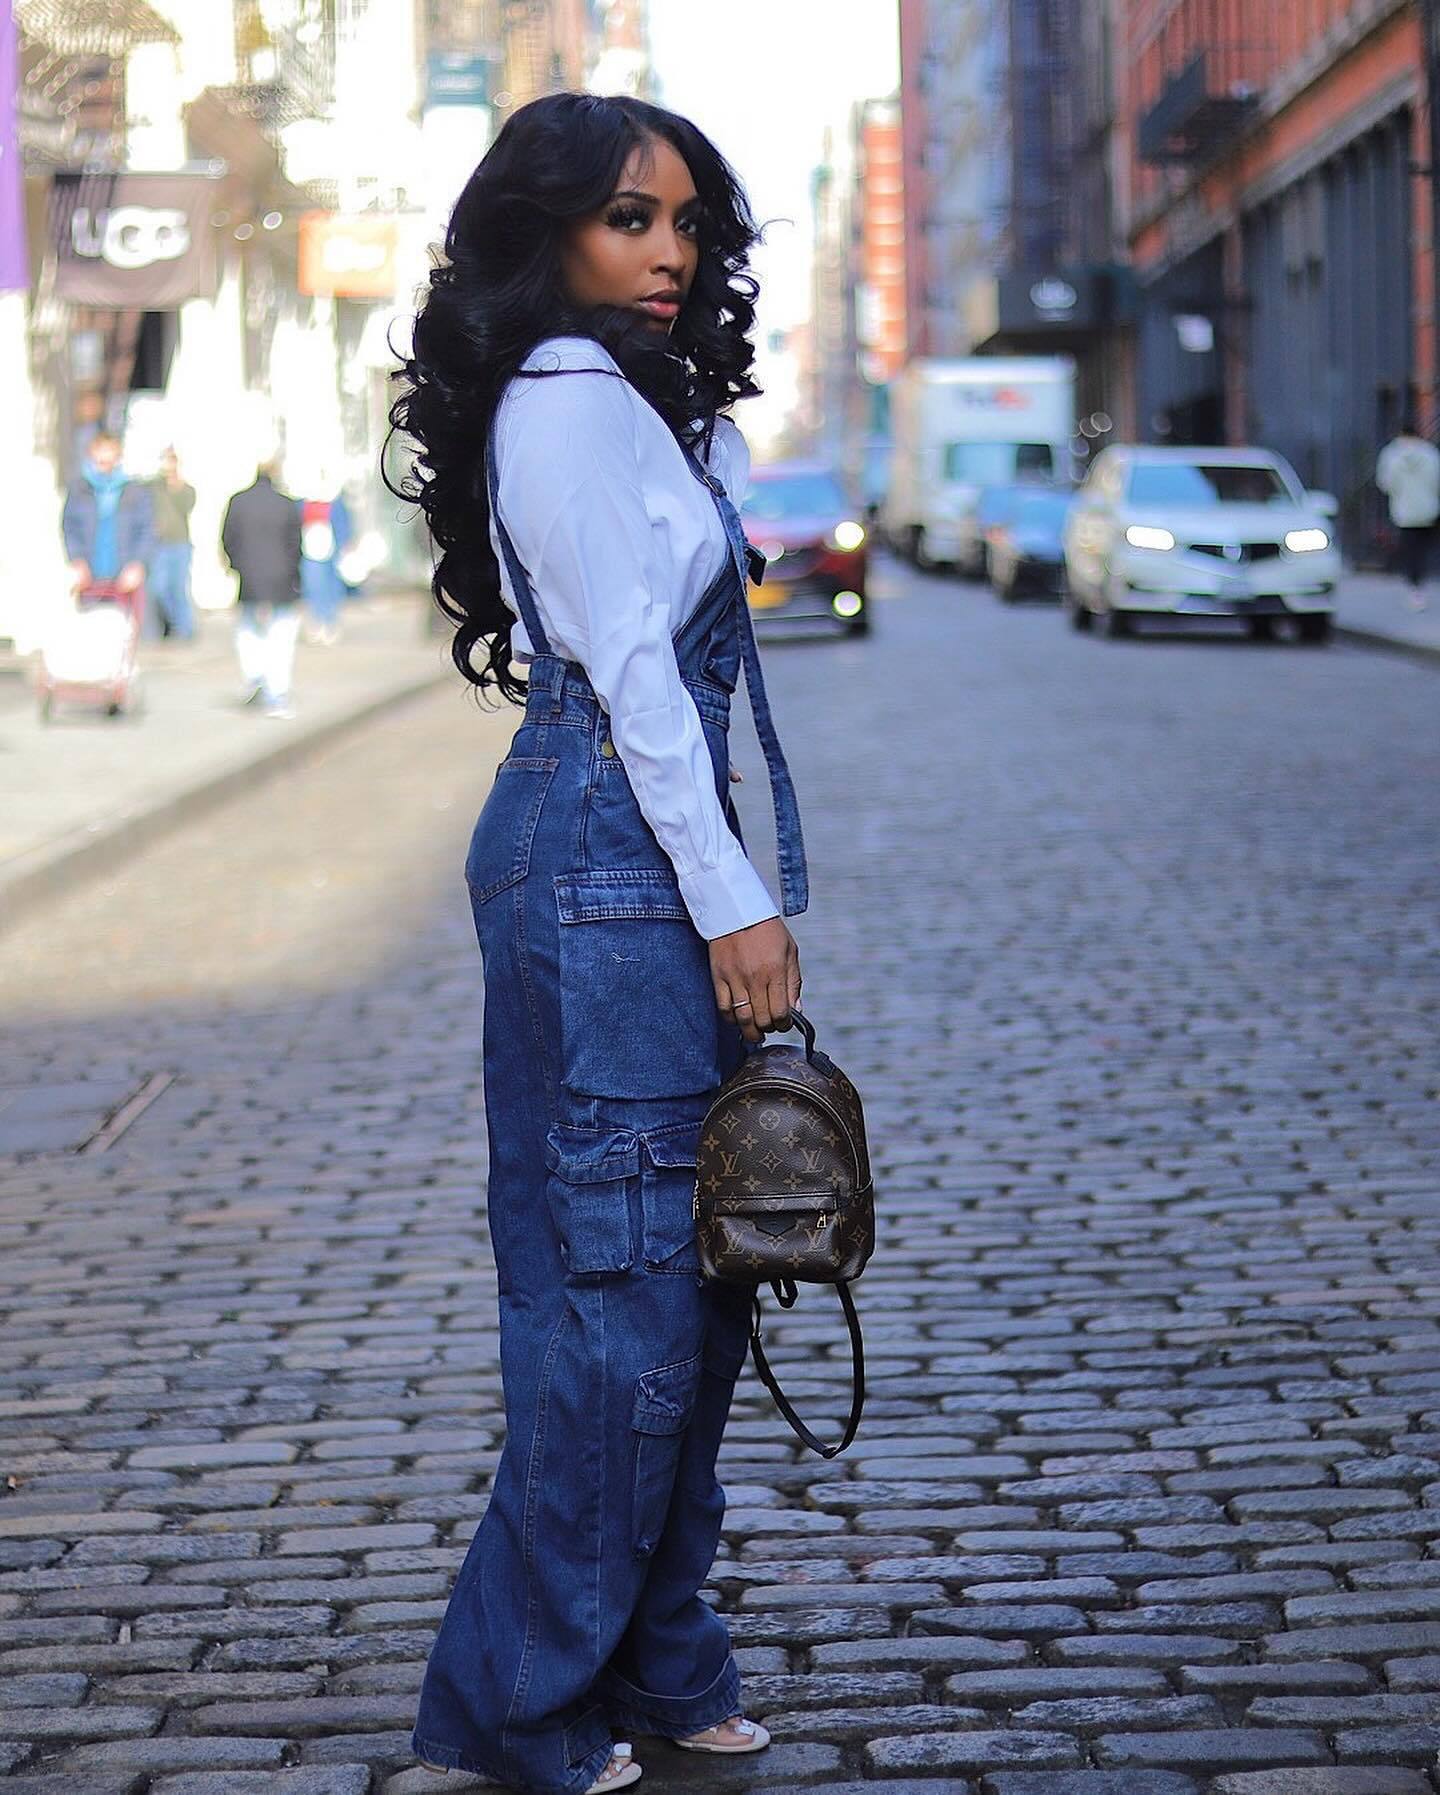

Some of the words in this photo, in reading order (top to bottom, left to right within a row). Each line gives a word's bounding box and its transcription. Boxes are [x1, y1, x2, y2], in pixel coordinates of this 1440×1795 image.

[719, 1150, 742, 1176] LV
[800, 1147, 825, 1173] LV
[721, 1228, 745, 1255] LV
[804, 1228, 828, 1252] LV
